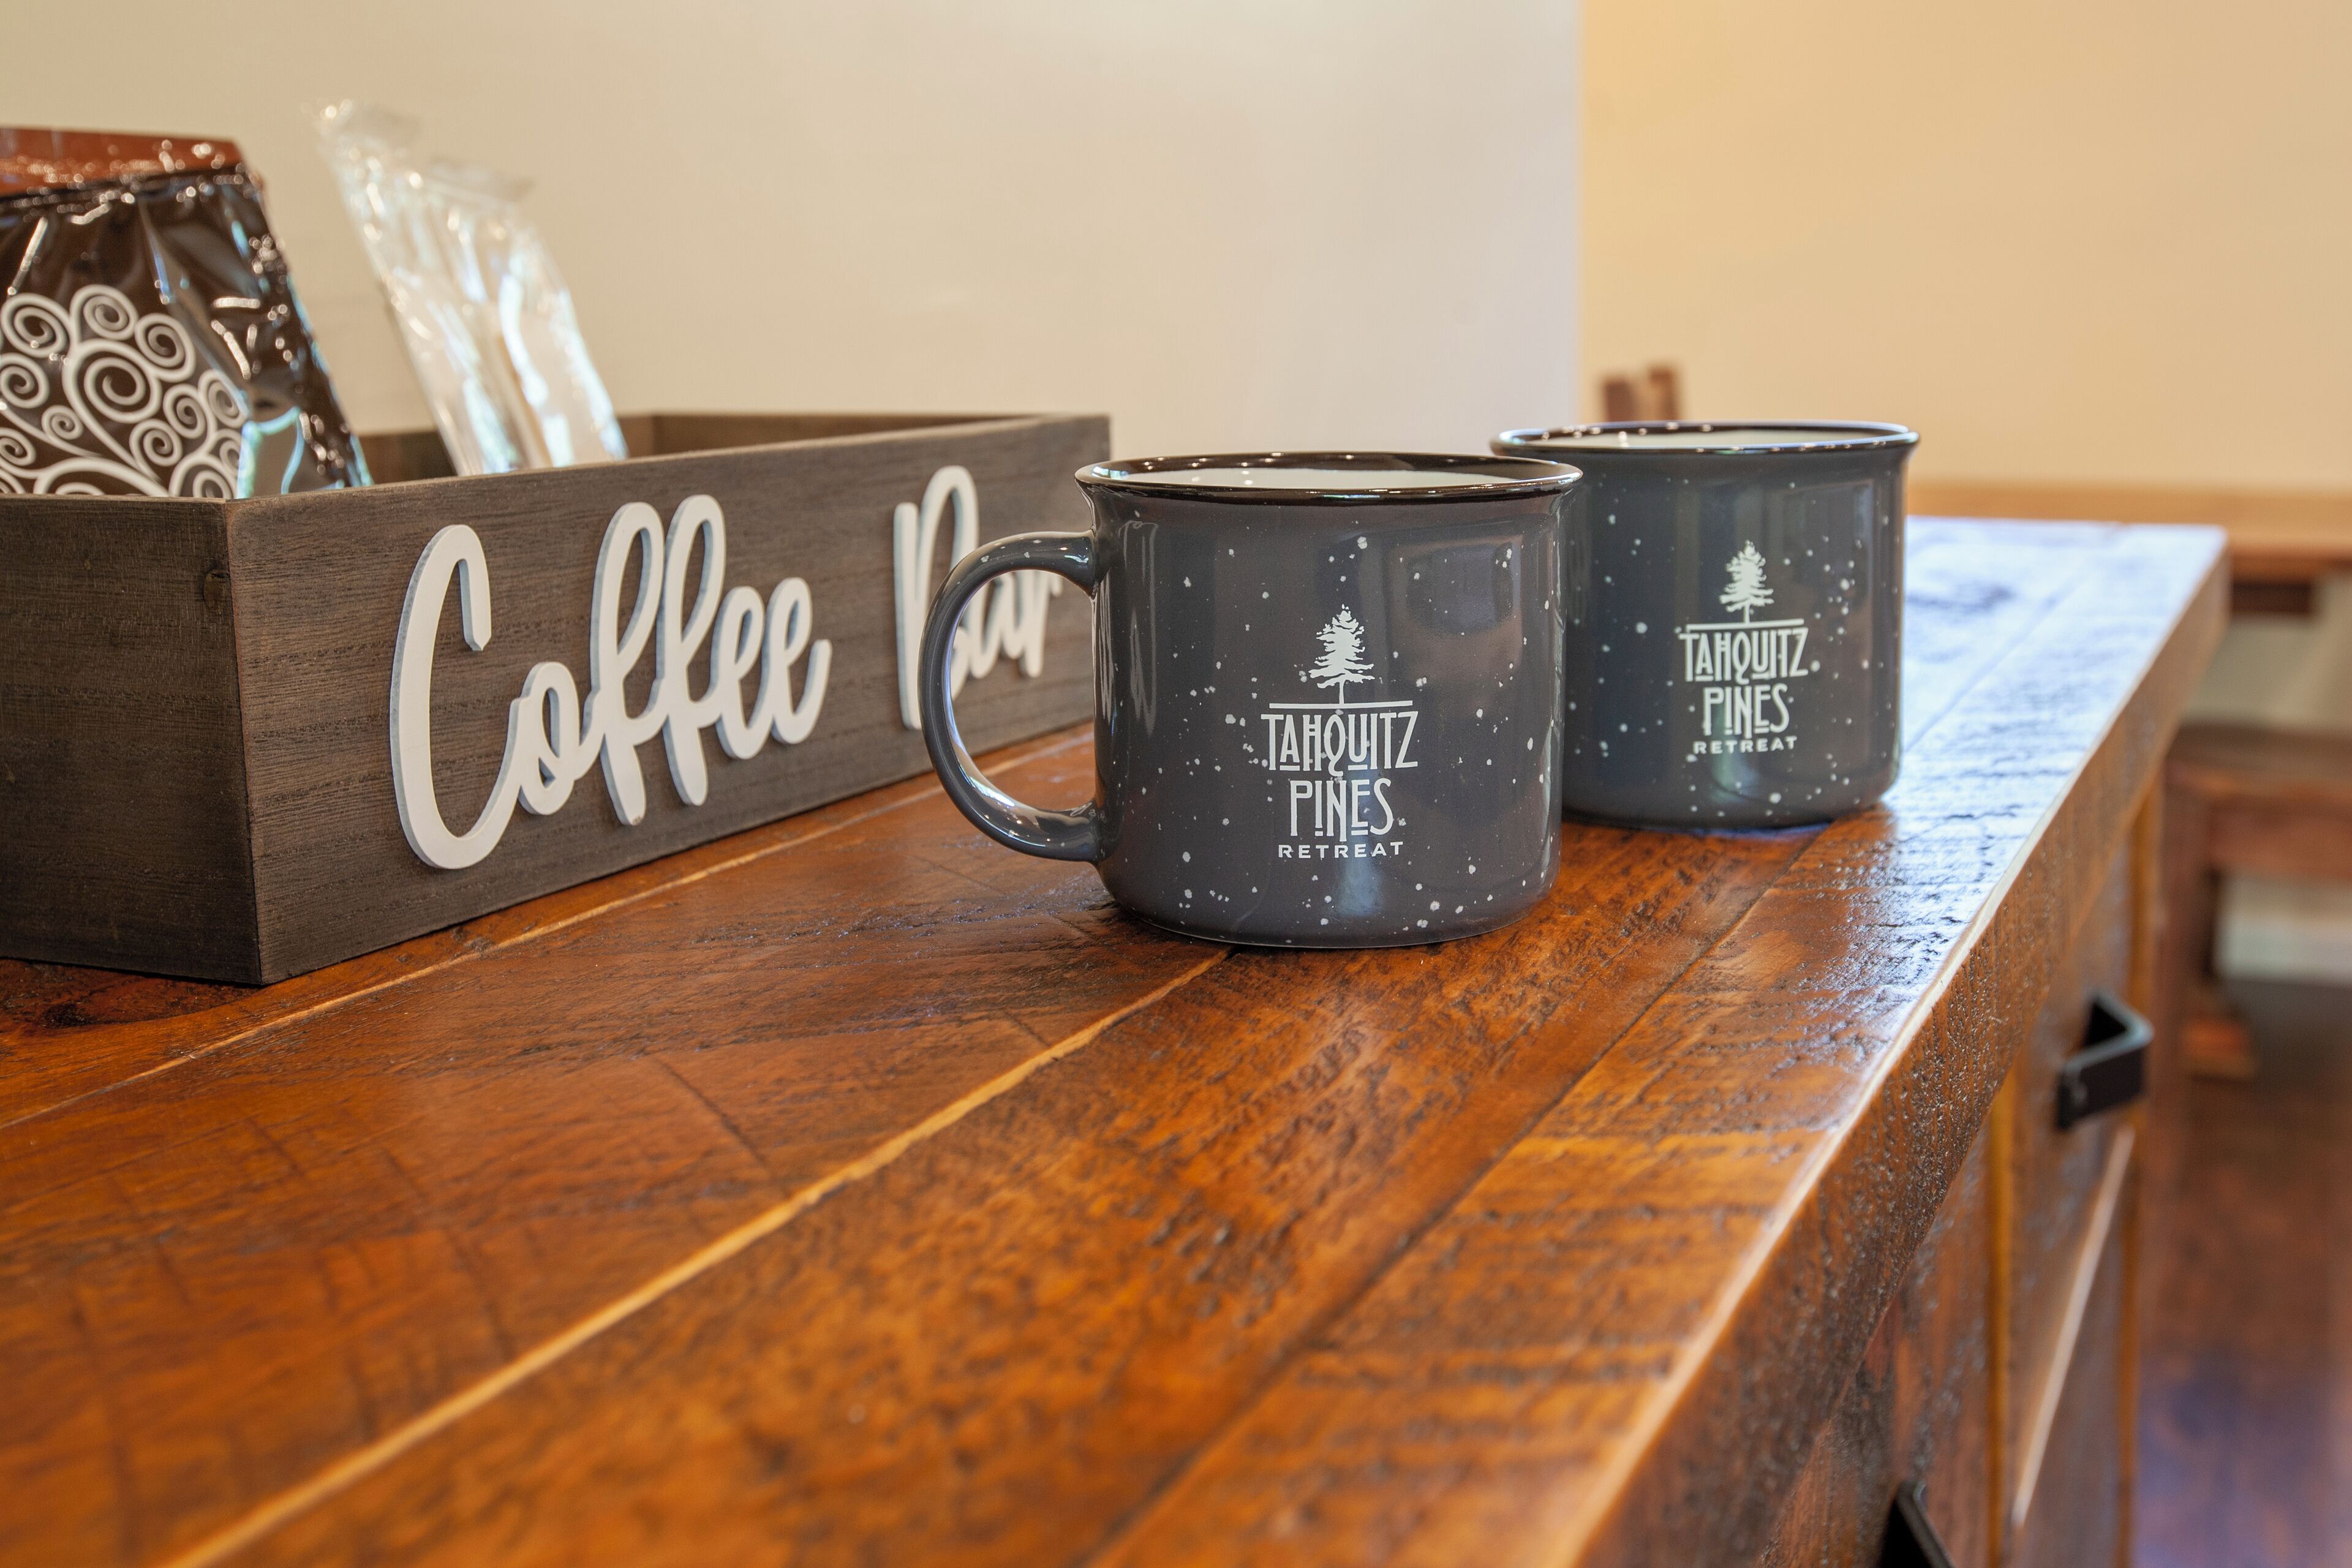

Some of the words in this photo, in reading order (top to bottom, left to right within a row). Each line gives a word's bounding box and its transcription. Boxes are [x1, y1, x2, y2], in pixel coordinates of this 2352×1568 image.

[390, 494, 832, 871] Coffee
[894, 465, 1063, 730] Bar
[1676, 627, 1809, 685] TAHQUITZ
[1703, 683, 1790, 739] PINES
[1261, 710, 1419, 777] TAHQUITZ
[1693, 736, 1798, 755] RETREAT
[1290, 778, 1393, 842] PINES
[1278, 841, 1404, 859] RETREAT
